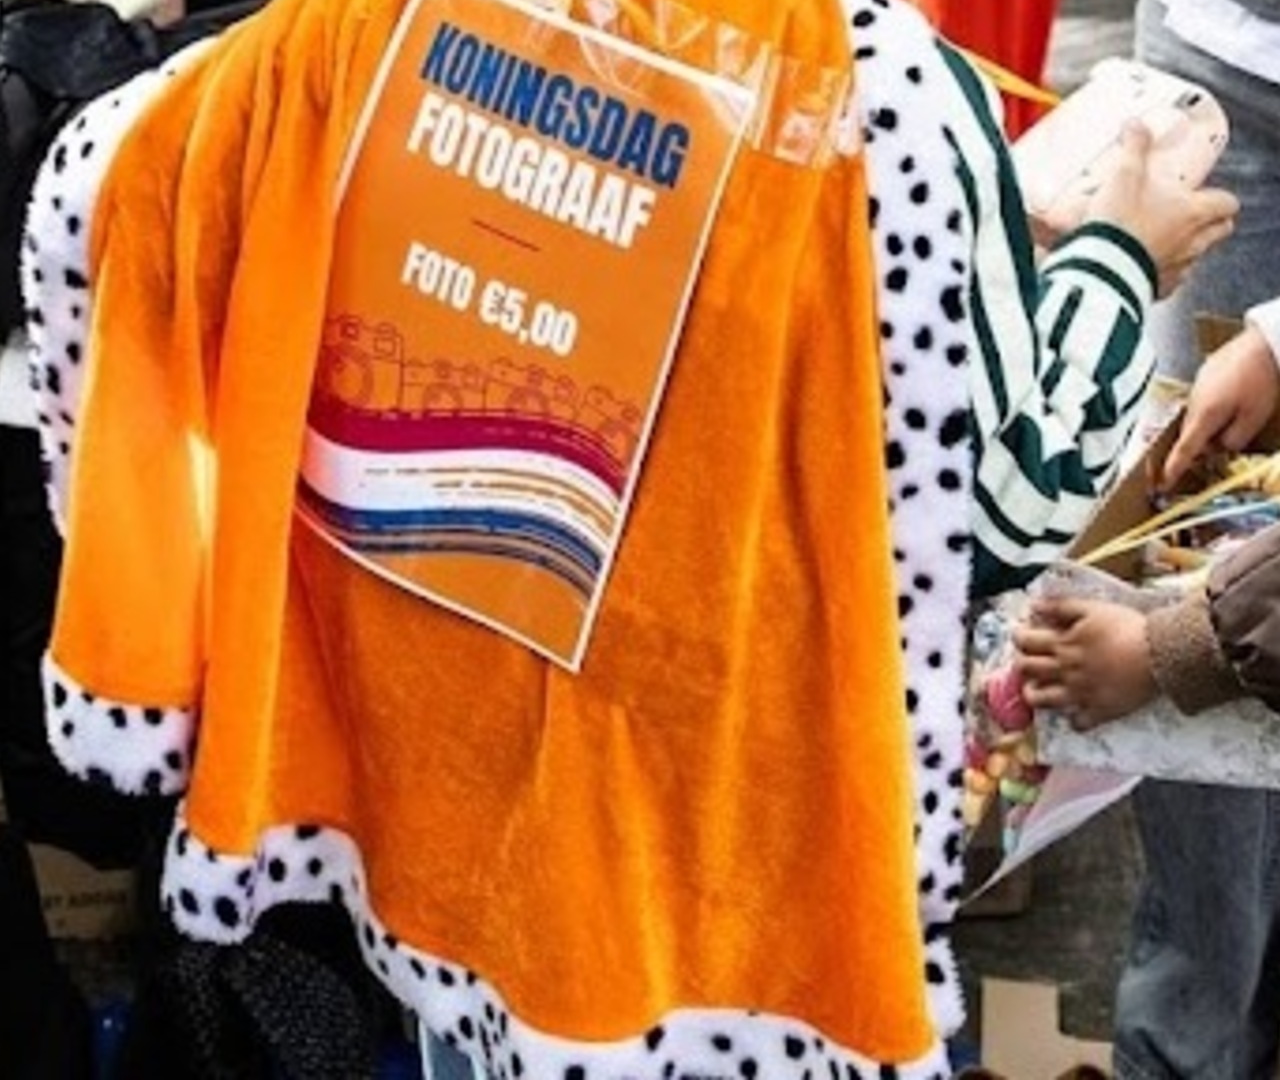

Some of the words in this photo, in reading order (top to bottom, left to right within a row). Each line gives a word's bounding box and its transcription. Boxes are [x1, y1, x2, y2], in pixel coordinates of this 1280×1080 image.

[406, 90, 657, 249] FOTOGRAAF
[420, 21, 690, 188] KONINGSDAG
[400, 240, 476, 311] FOTO
[478, 279, 578, 357] €5,00
